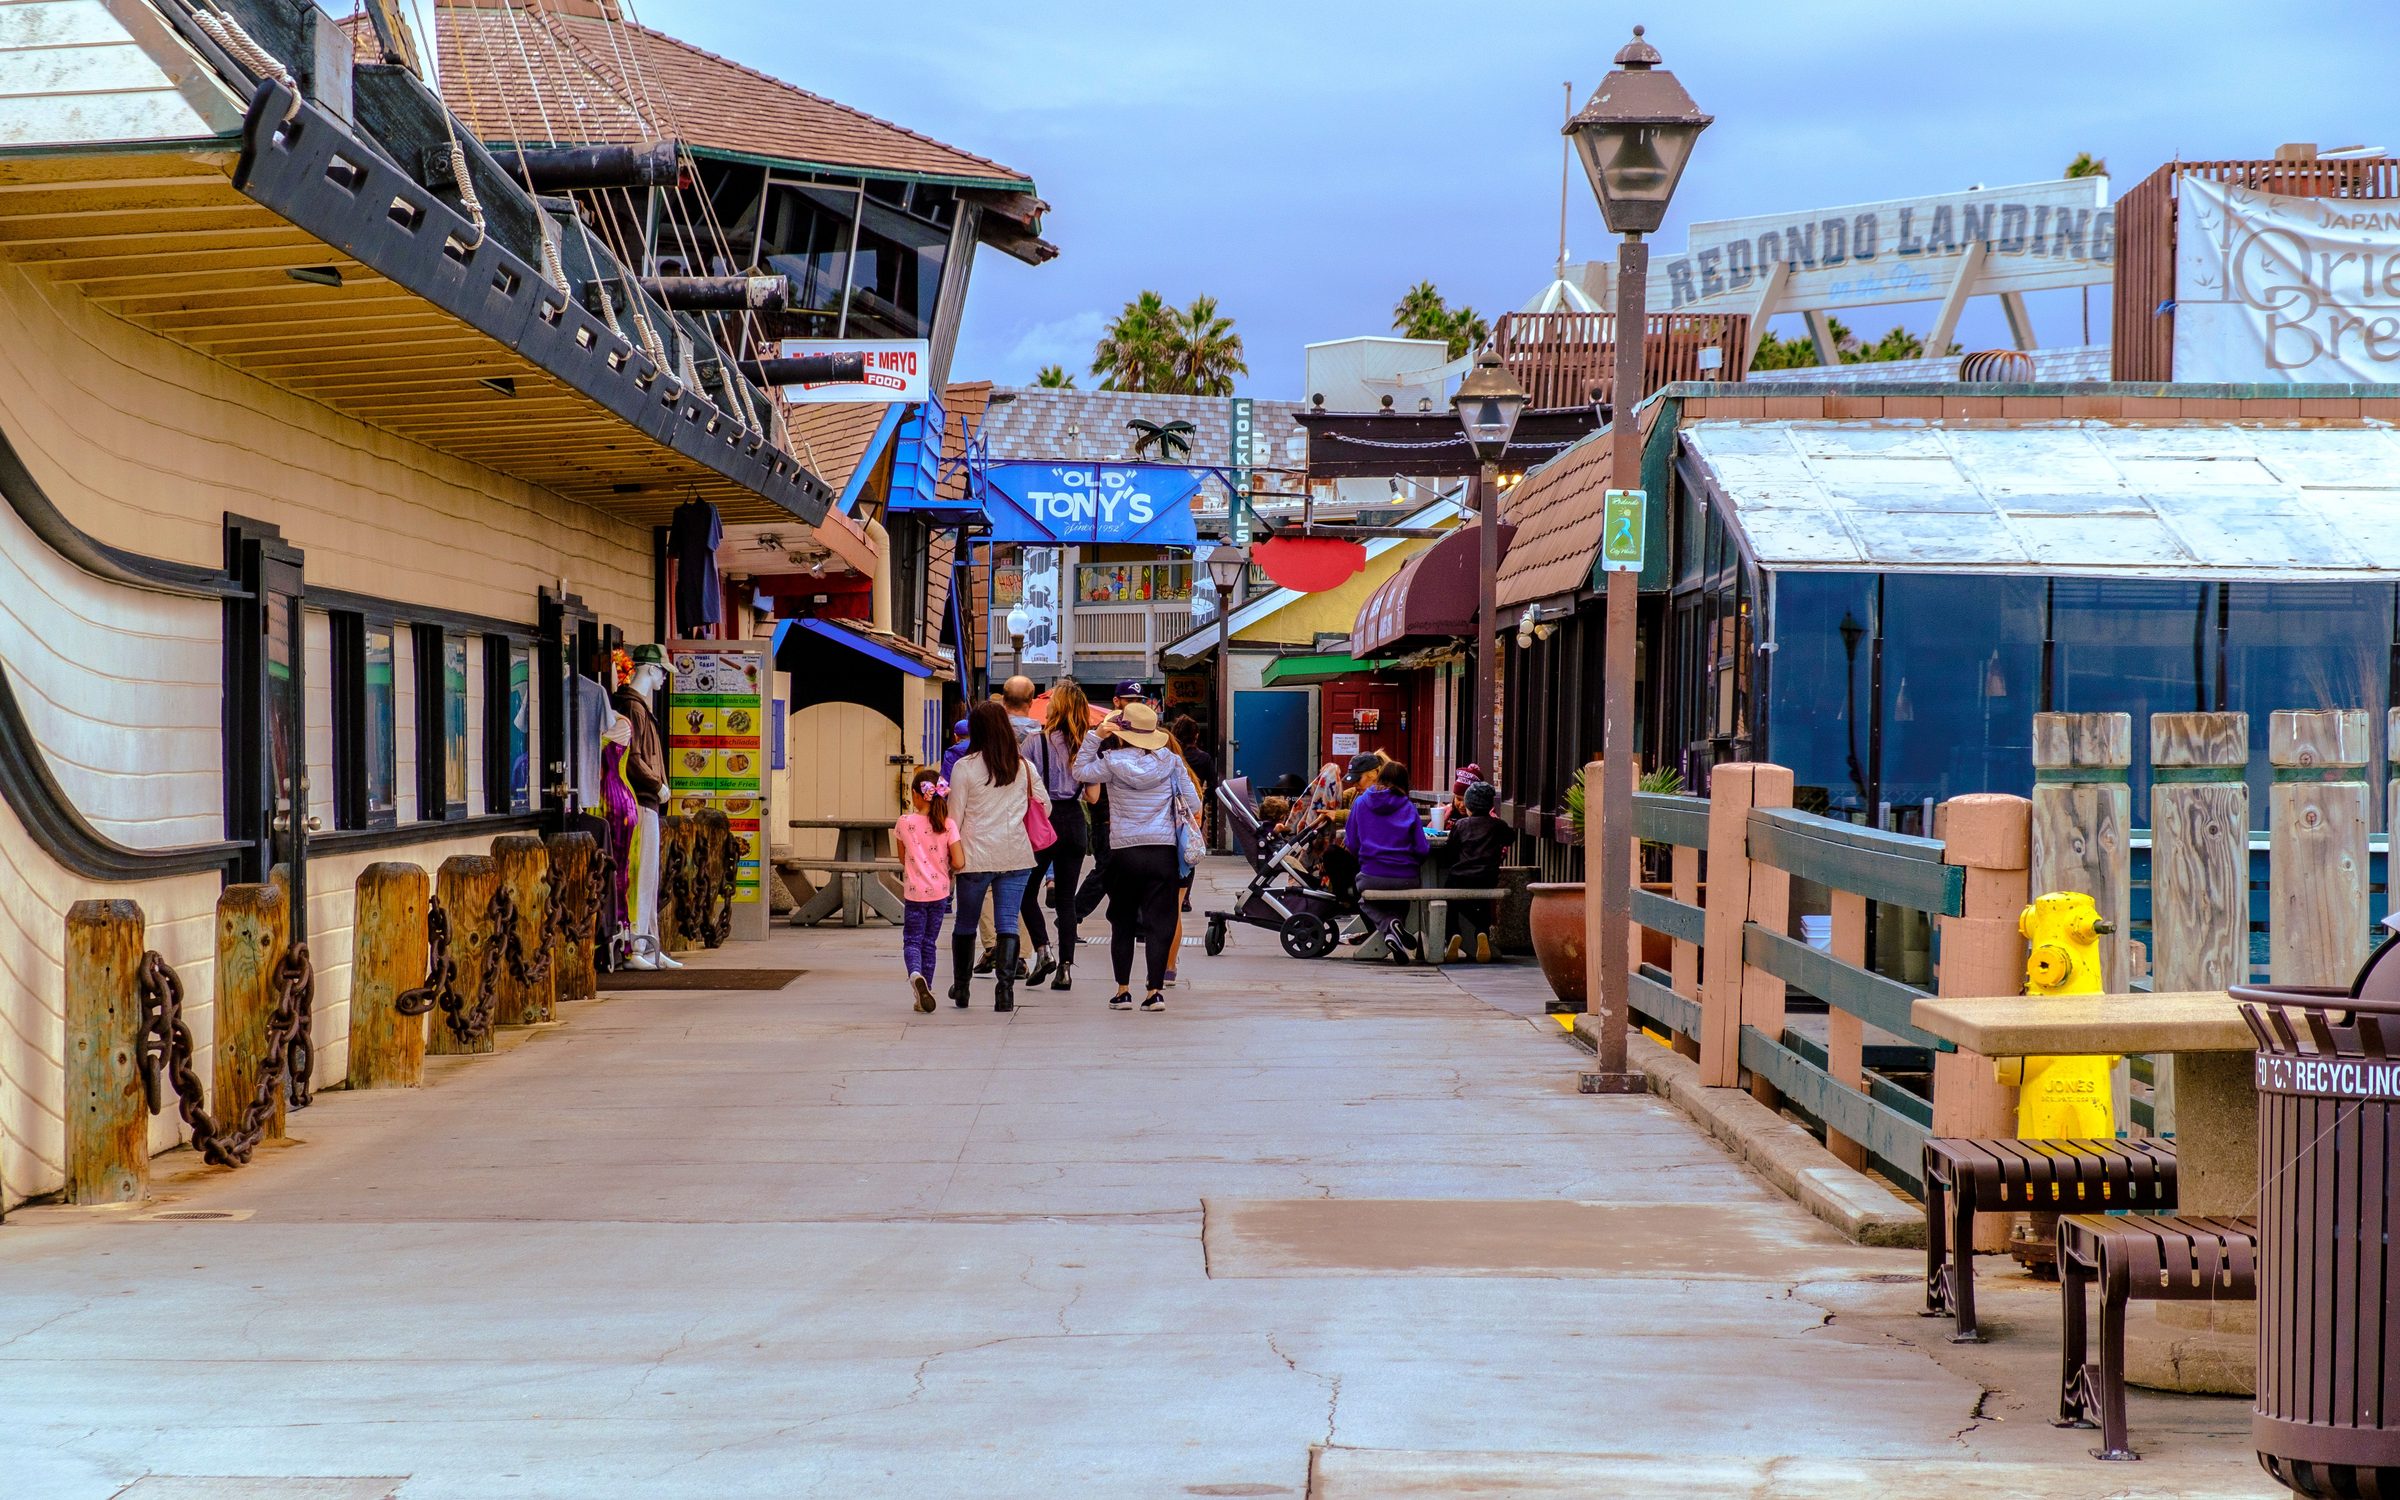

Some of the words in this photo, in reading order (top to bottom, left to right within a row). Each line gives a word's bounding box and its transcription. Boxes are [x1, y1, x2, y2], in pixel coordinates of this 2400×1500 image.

[1667, 212, 1879, 309] REDONDO
[1899, 203, 2115, 268] LANDING
[2264, 286, 2400, 370] Bre
[868, 376, 901, 389] FOOD
[879, 352, 917, 376] MAYO
[1236, 403, 1250, 542] COCKTAILS
[1028, 485, 1154, 524] TONY'S
[2046, 1080, 2094, 1093] JONES
[2296, 1061, 2400, 1097] RECYCLING
